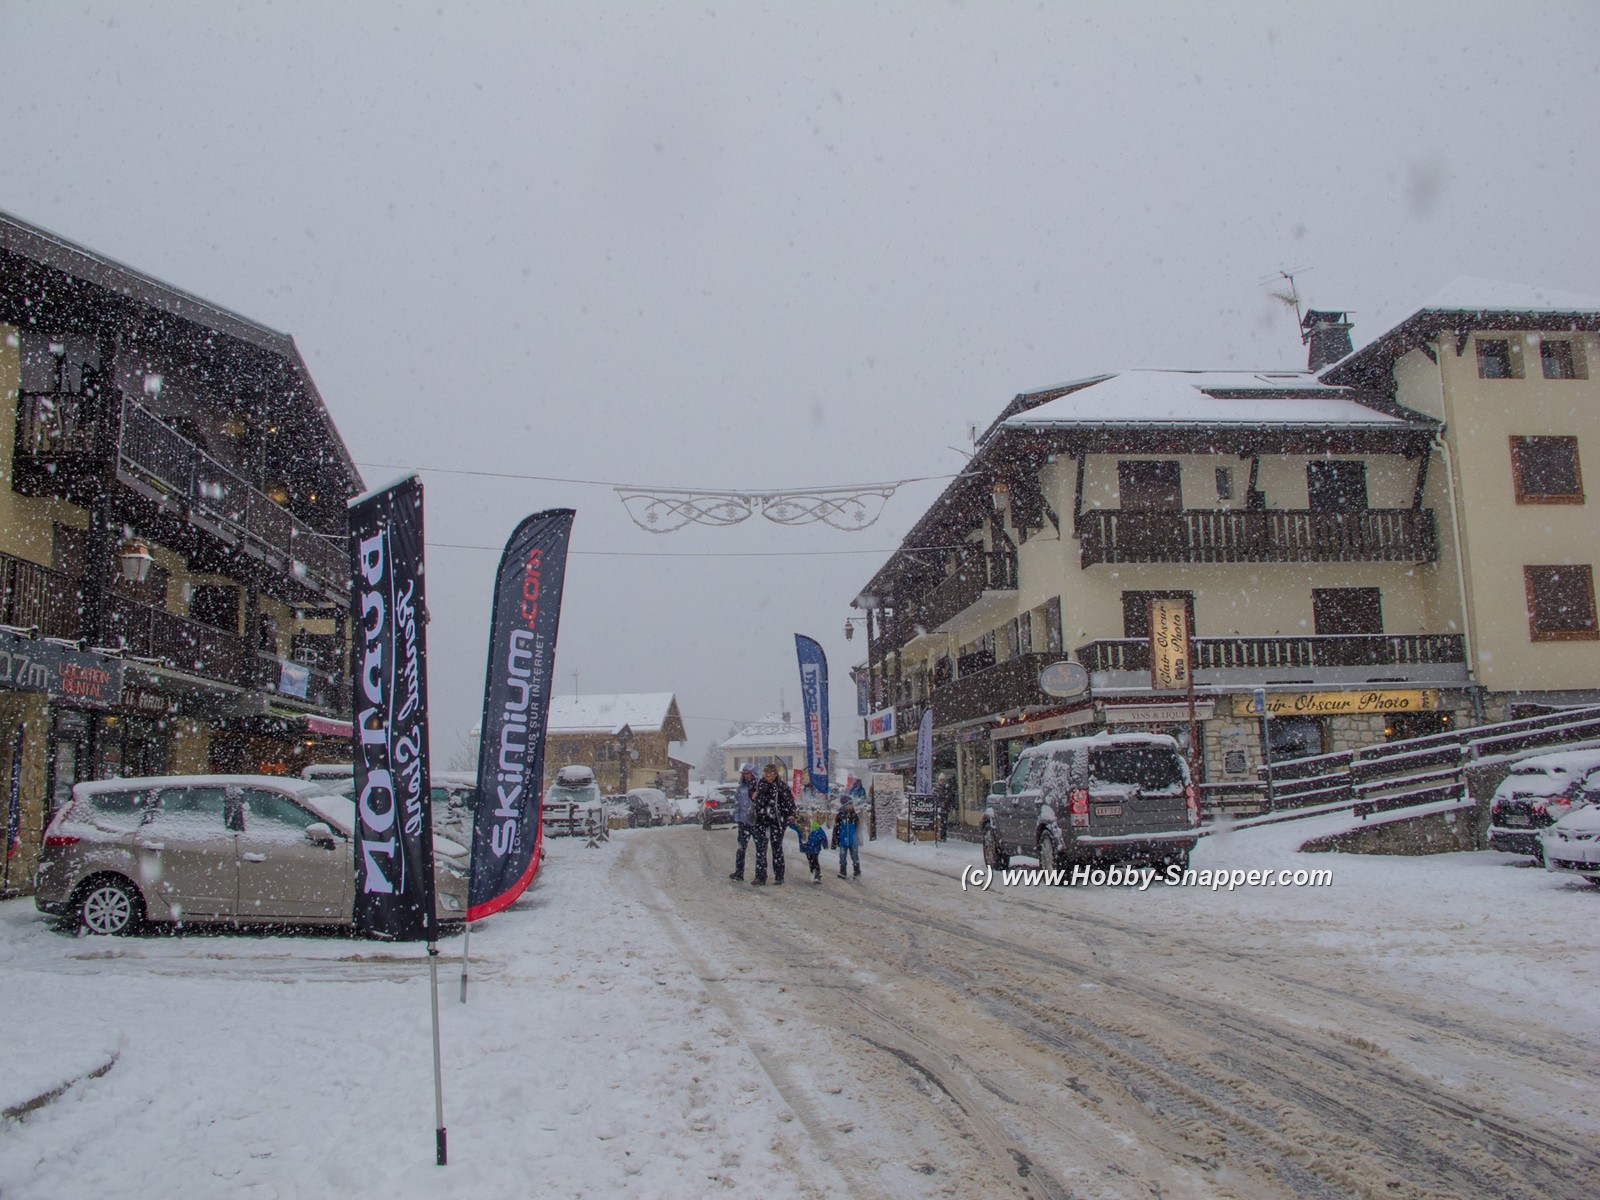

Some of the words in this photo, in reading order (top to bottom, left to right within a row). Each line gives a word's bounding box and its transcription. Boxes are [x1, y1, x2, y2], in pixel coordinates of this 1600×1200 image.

[1171, 614, 1184, 654] Photo
[58, 661, 110, 685] LOCATION
[532, 633, 545, 698] INTERNET
[62, 679, 104, 699] RENTAL
[529, 702, 539, 728] SUR
[1131, 711, 1151, 719] VINS
[1152, 711, 1160, 719] &
[1161, 710, 1202, 719] LIQUES
[1246, 695, 1351, 714] Cair-Obscur
[1358, 692, 1409, 710] Photo
[527, 733, 537, 762] SKIS
